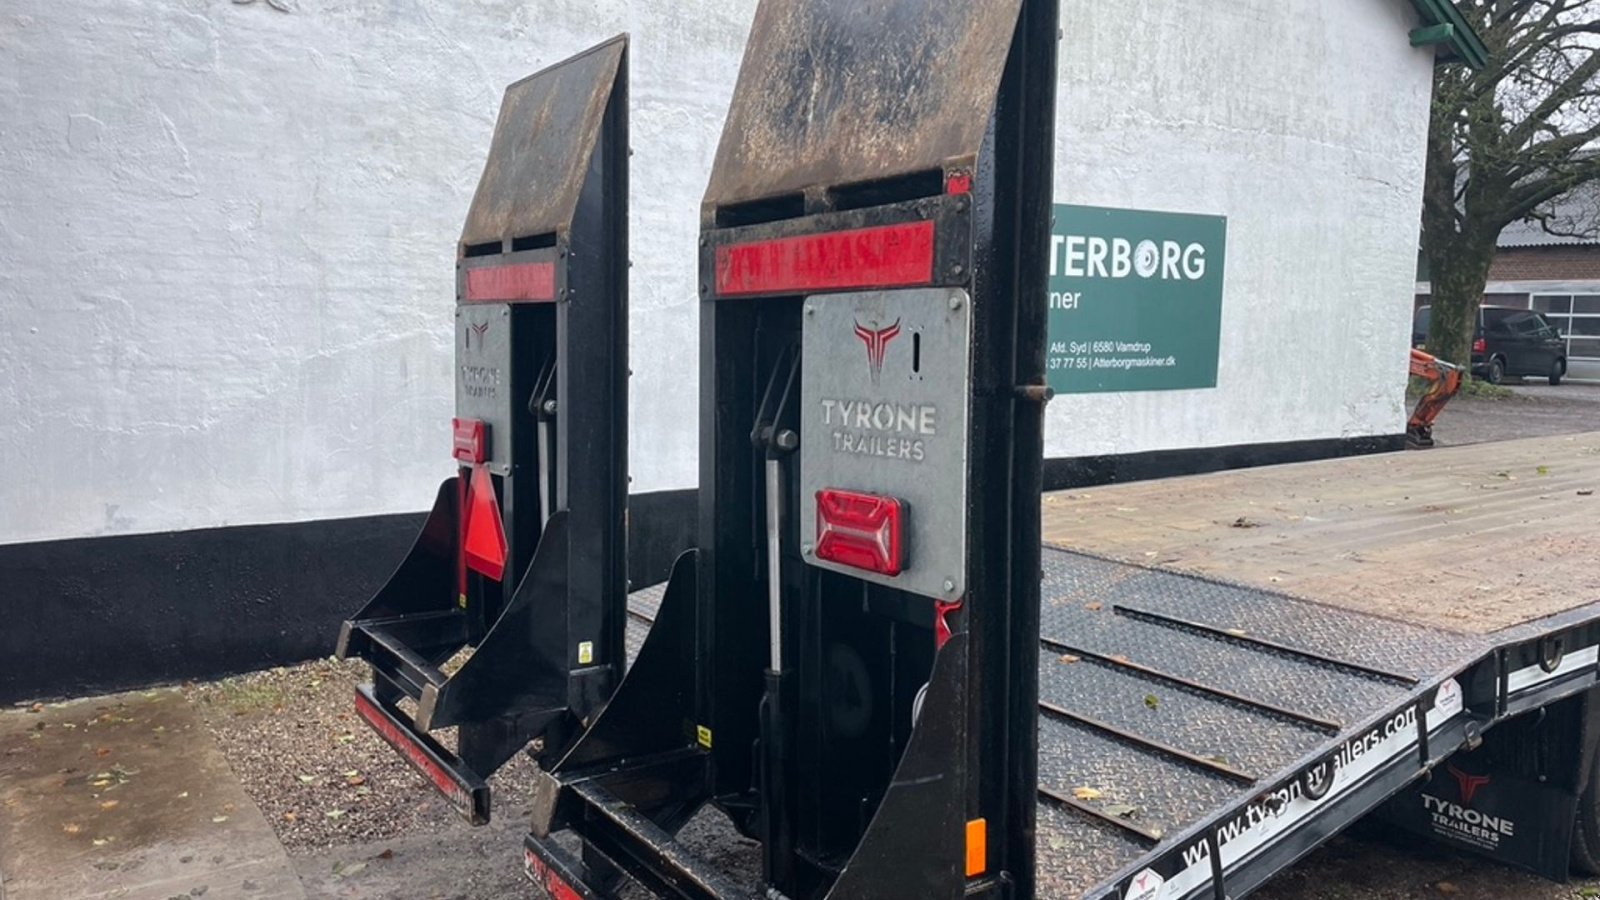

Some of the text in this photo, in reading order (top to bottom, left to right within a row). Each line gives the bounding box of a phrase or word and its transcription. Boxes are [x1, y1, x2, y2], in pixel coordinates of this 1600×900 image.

[1050, 341, 1067, 353] Afd.
[1070, 341, 1087, 355] Syd
[1093, 341, 1114, 353] 6580
[1115, 341, 1151, 354] Vamdrup
[1050, 358, 1062, 369] 37
[1063, 358, 1074, 369] 77
[1076, 357, 1088, 369] 55
[1093, 355, 1176, 370] Atterborgmaskiner.dk
[821, 399, 936, 435] TYRONE
[833, 432, 924, 460] TRAILERS
[1182, 703, 1417, 867] www.tyonetailers.com
[1421, 793, 1514, 836] TYRONE
[1431, 812, 1499, 842] TRAILERS
